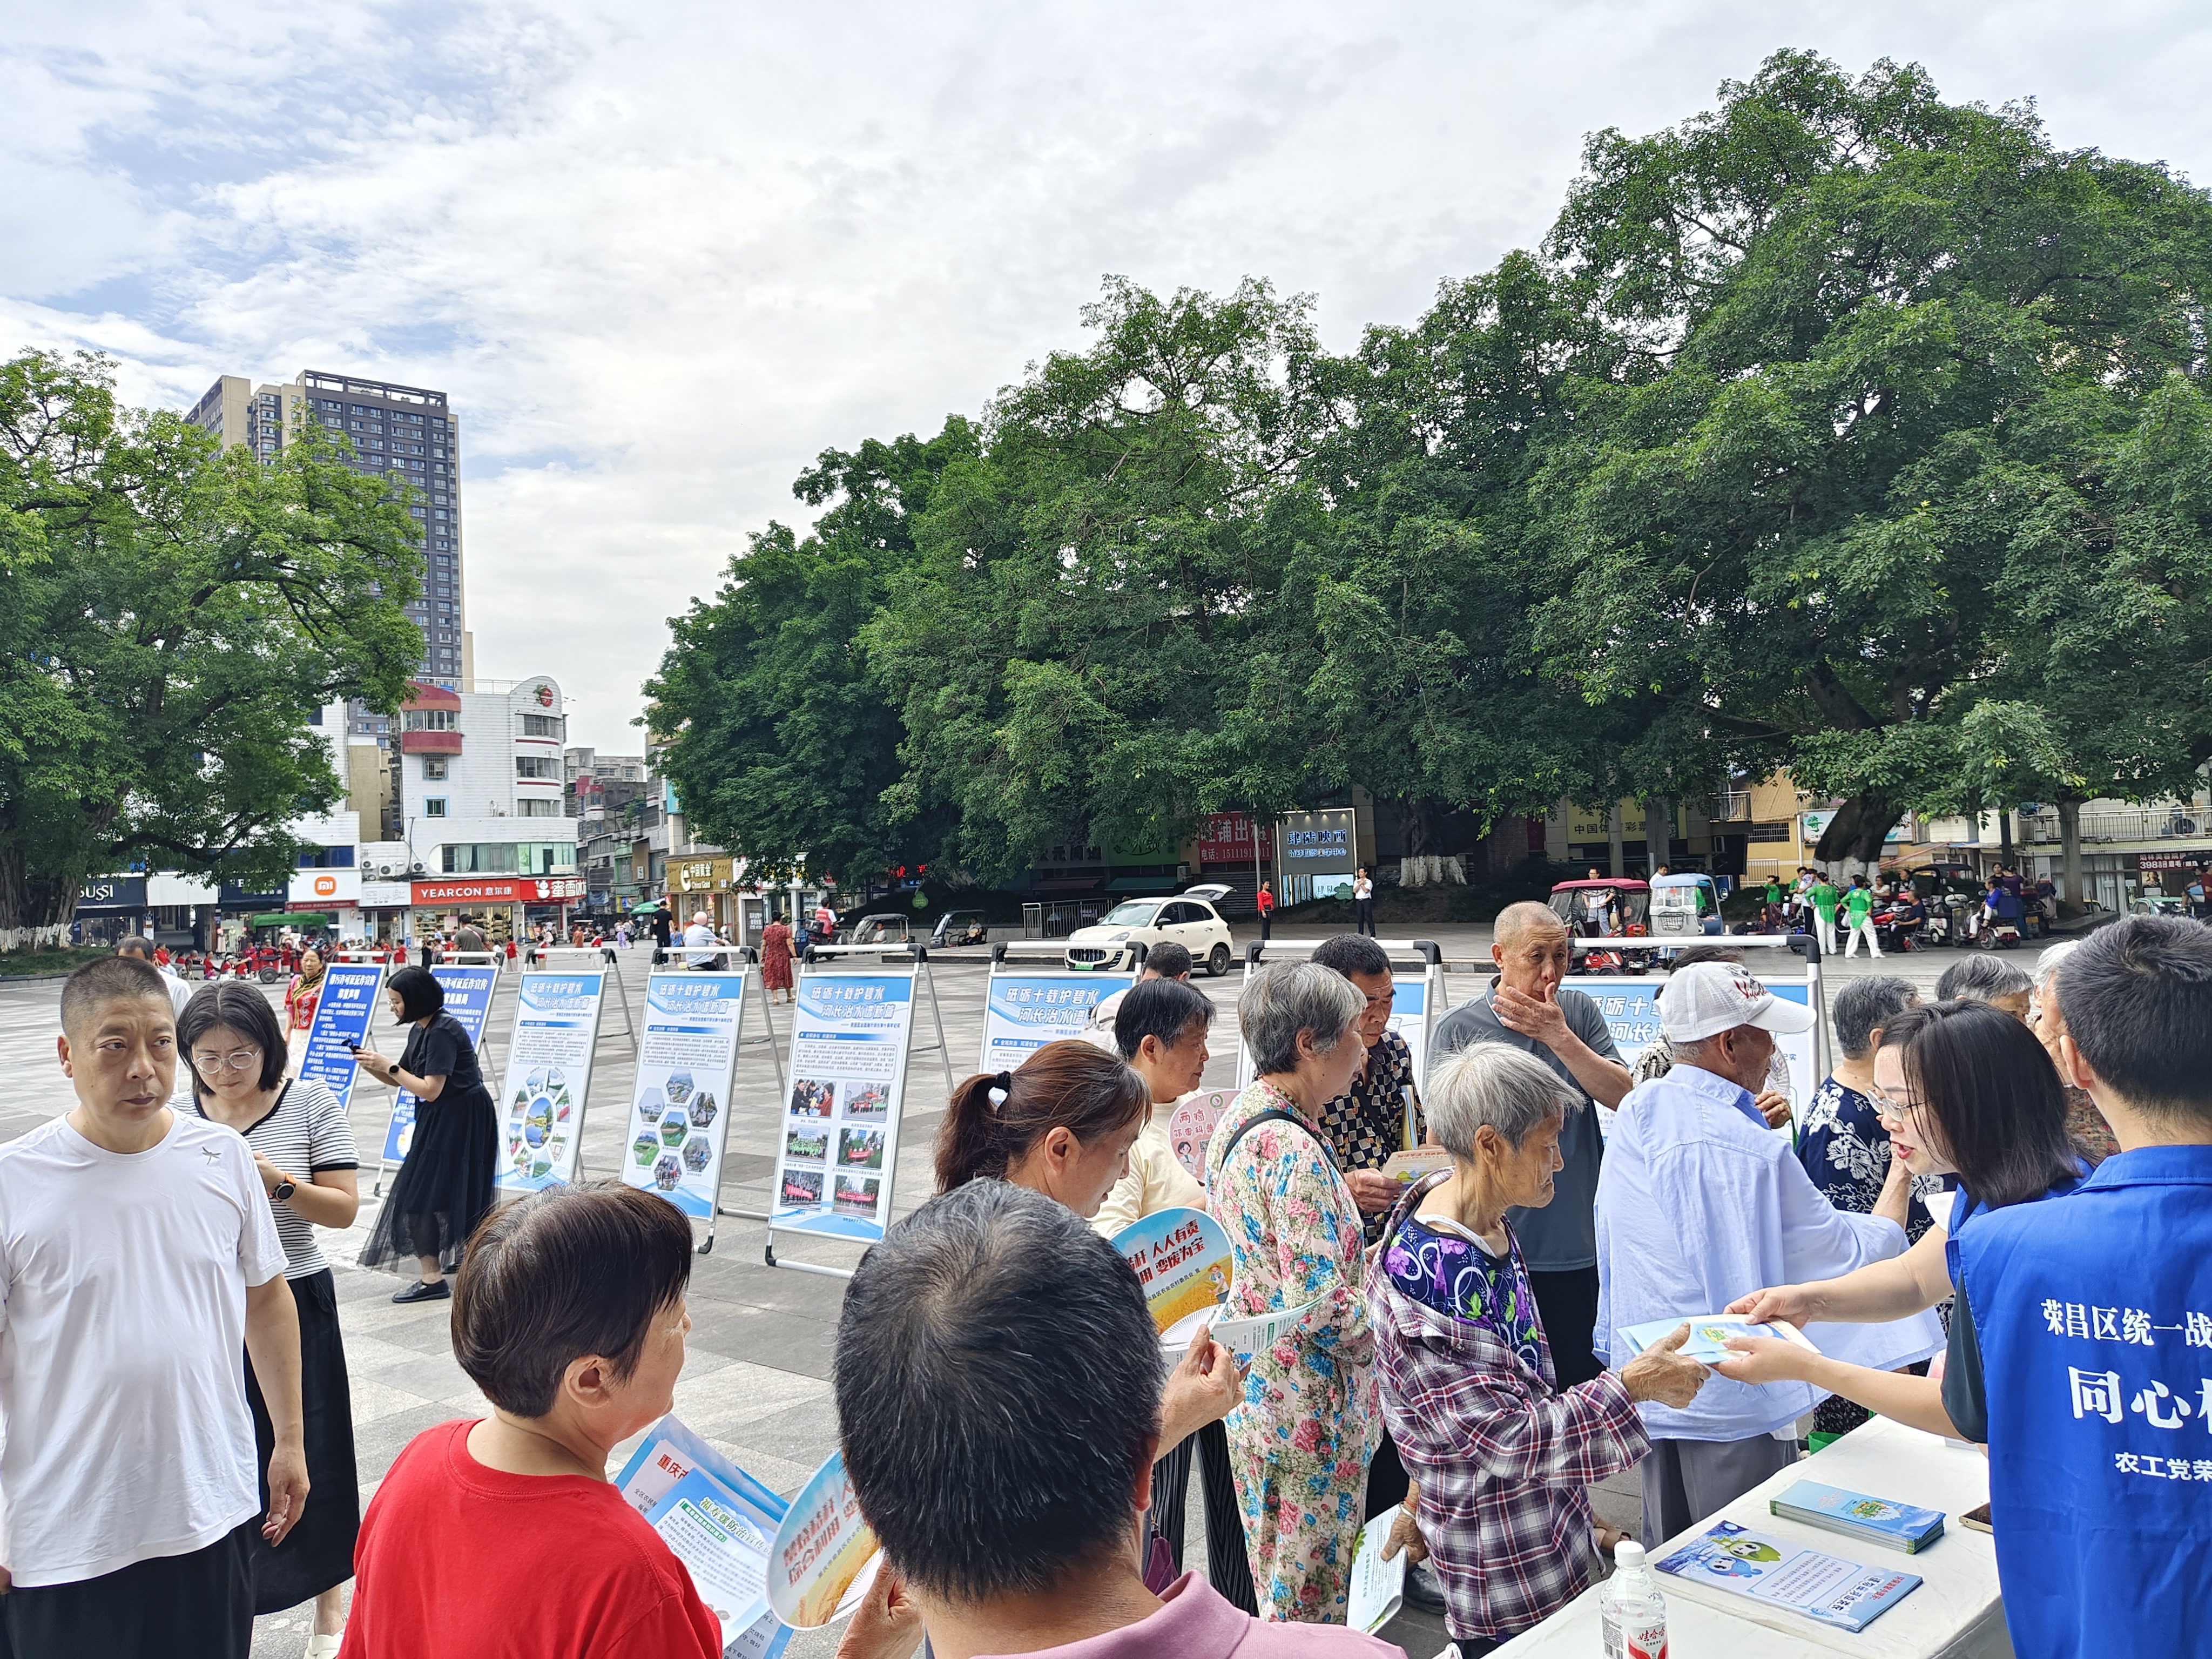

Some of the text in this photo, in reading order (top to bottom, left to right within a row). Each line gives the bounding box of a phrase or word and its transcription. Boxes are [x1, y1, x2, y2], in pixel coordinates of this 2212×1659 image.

[1574, 821, 1646, 835] 中国体彩票
[1287, 830, 1347, 845] 肆陆映画
[690, 862, 711, 877] 中国黄金
[702, 880, 711, 888] Gold
[421, 886, 512, 898] YEARCON 意尔康
[811, 986, 886, 1001] 砥砺十载护碧水
[1006, 987, 1100, 1005] 砥砺十载护碧水
[821, 1003, 895, 1019] 河长治水谱新篇
[1179, 1109, 1204, 1124] 两癌
[1174, 1123, 1214, 1138] 筛查科普
[1152, 1219, 1200, 1259] 人人有责
[1155, 1237, 1205, 1276] 变废为宝
[2040, 1298, 2212, 1348] 荣昌区统一战
[2115, 1452, 2212, 1482] 农工党荣
[788, 1515, 840, 1588] 综合利用
[1637, 1626, 1665, 1642] 娃哈哈
